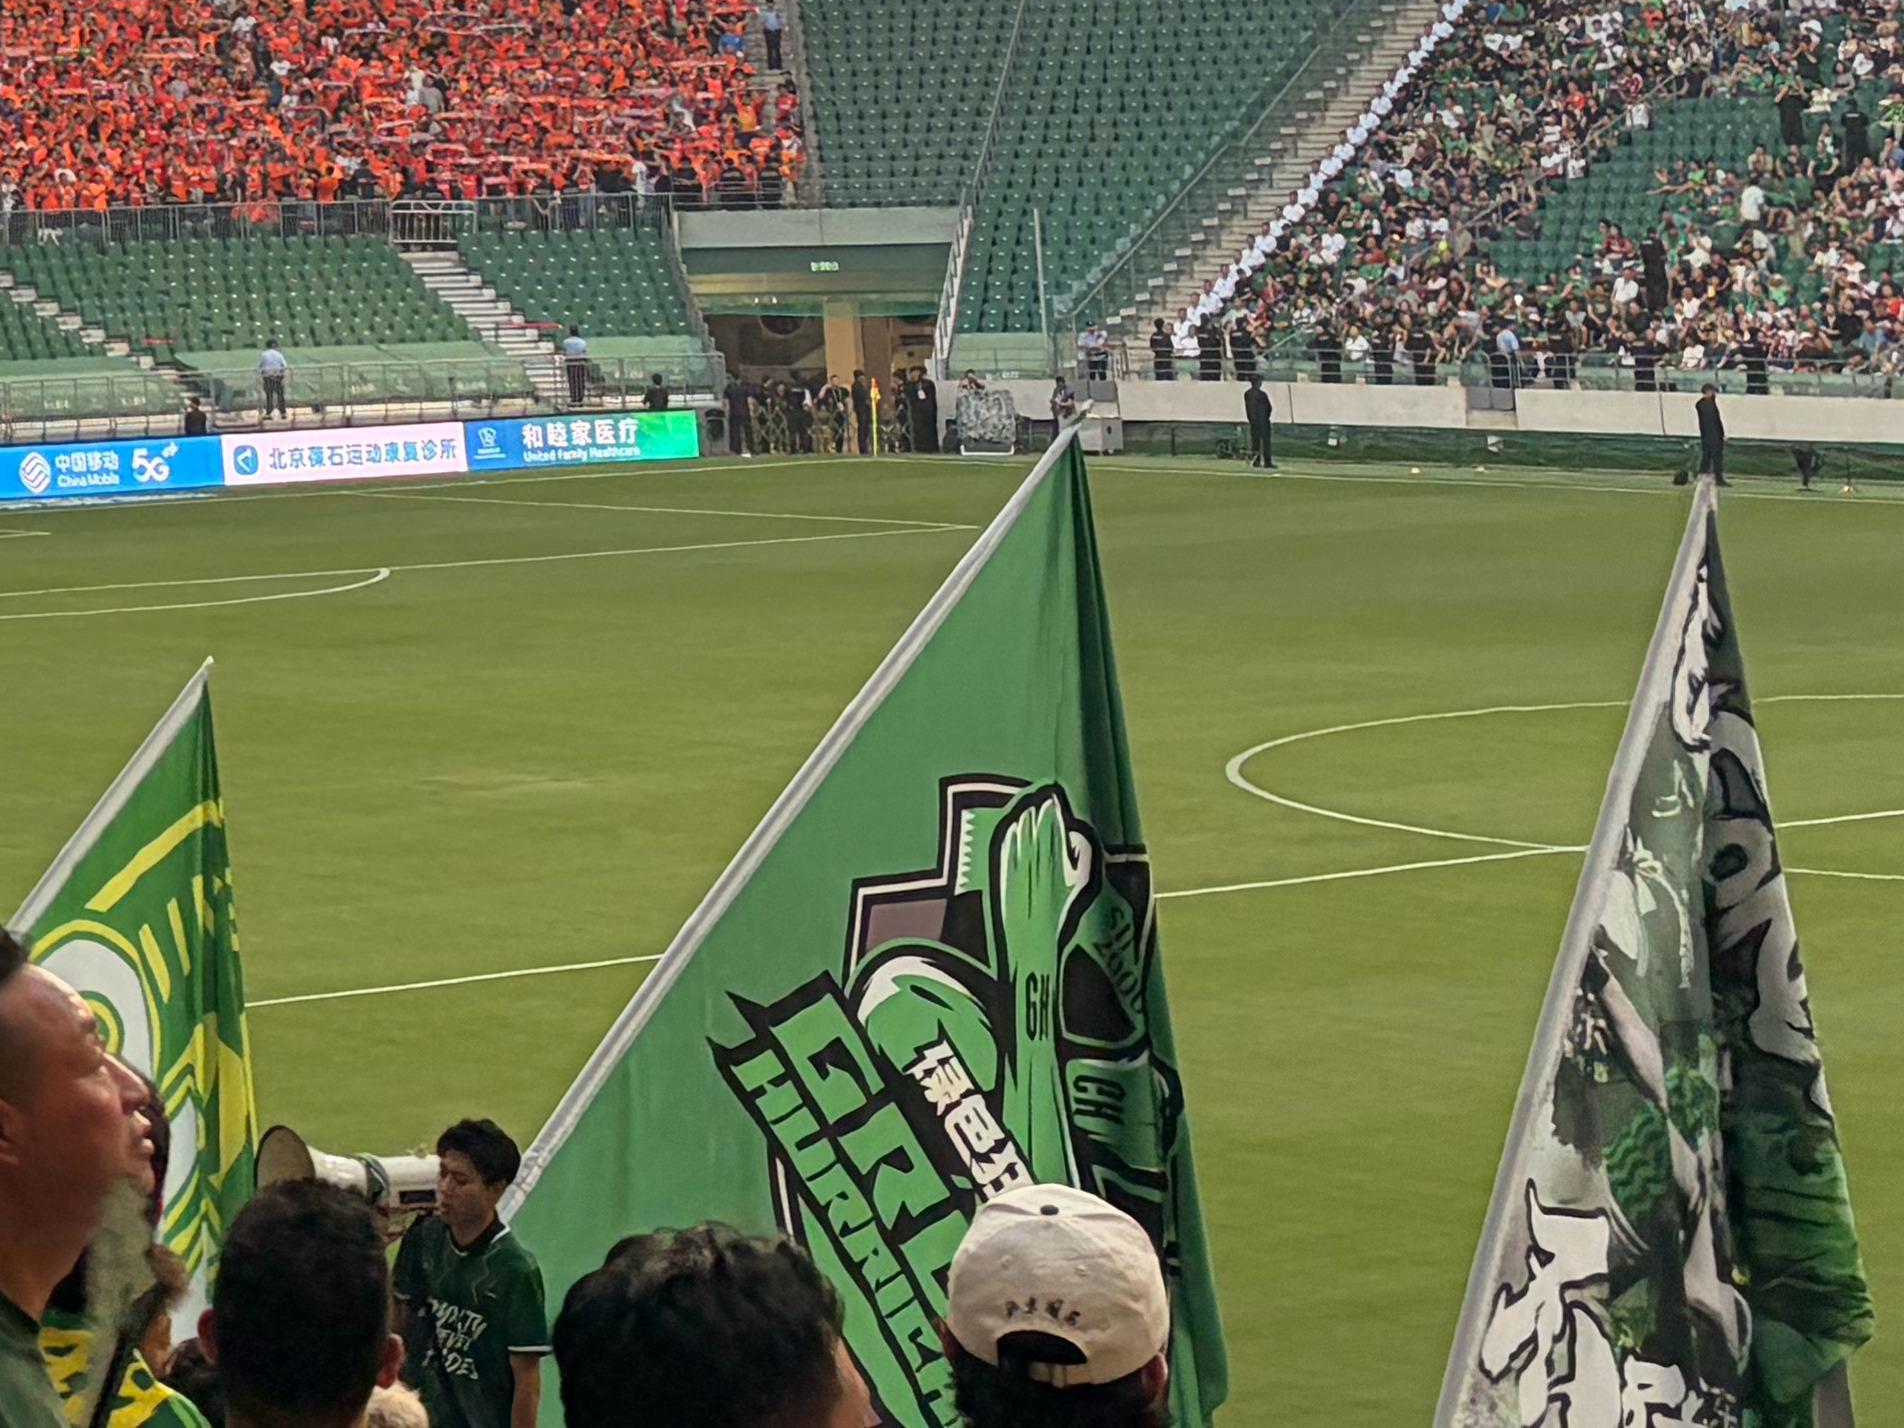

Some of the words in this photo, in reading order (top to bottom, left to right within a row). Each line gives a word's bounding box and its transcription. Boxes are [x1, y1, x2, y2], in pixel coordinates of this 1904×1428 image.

[522, 417, 639, 449] 和睦家医疗
[54, 450, 120, 472] 中国移动
[522, 449, 554, 463] United
[556, 448, 588, 463] Family
[589, 446, 640, 460] Healthcare
[57, 473, 89, 488] China
[91, 471, 120, 486] Mobile
[1024, 972, 1050, 1042] GH
